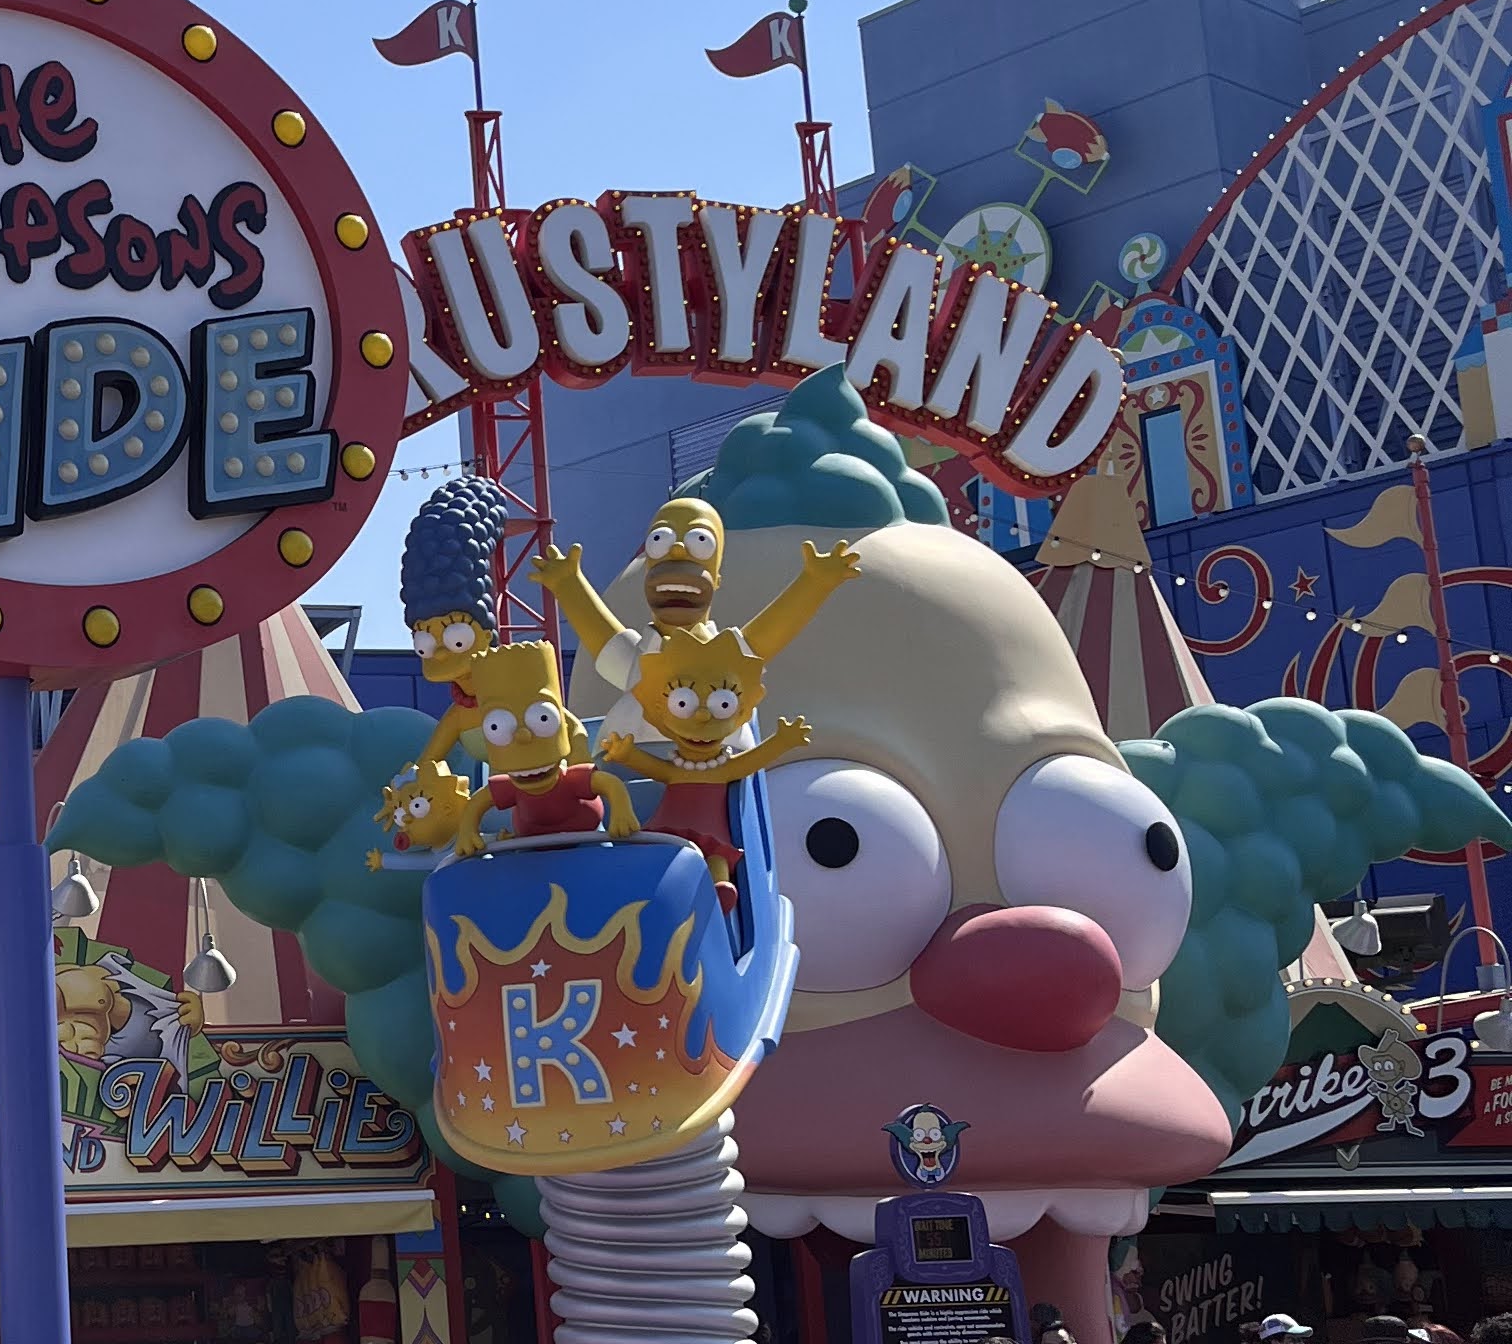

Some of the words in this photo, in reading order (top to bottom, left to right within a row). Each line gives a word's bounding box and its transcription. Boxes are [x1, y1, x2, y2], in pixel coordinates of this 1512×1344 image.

[437, 6, 465, 49] K
[769, 18, 797, 60] K
[502, 978, 611, 1108] K
[1239, 1053, 1372, 1128] trike
[1419, 1037, 1471, 1119] 3
[902, 1288, 985, 1304] WARNING
[1160, 1253, 1233, 1313] SWING
